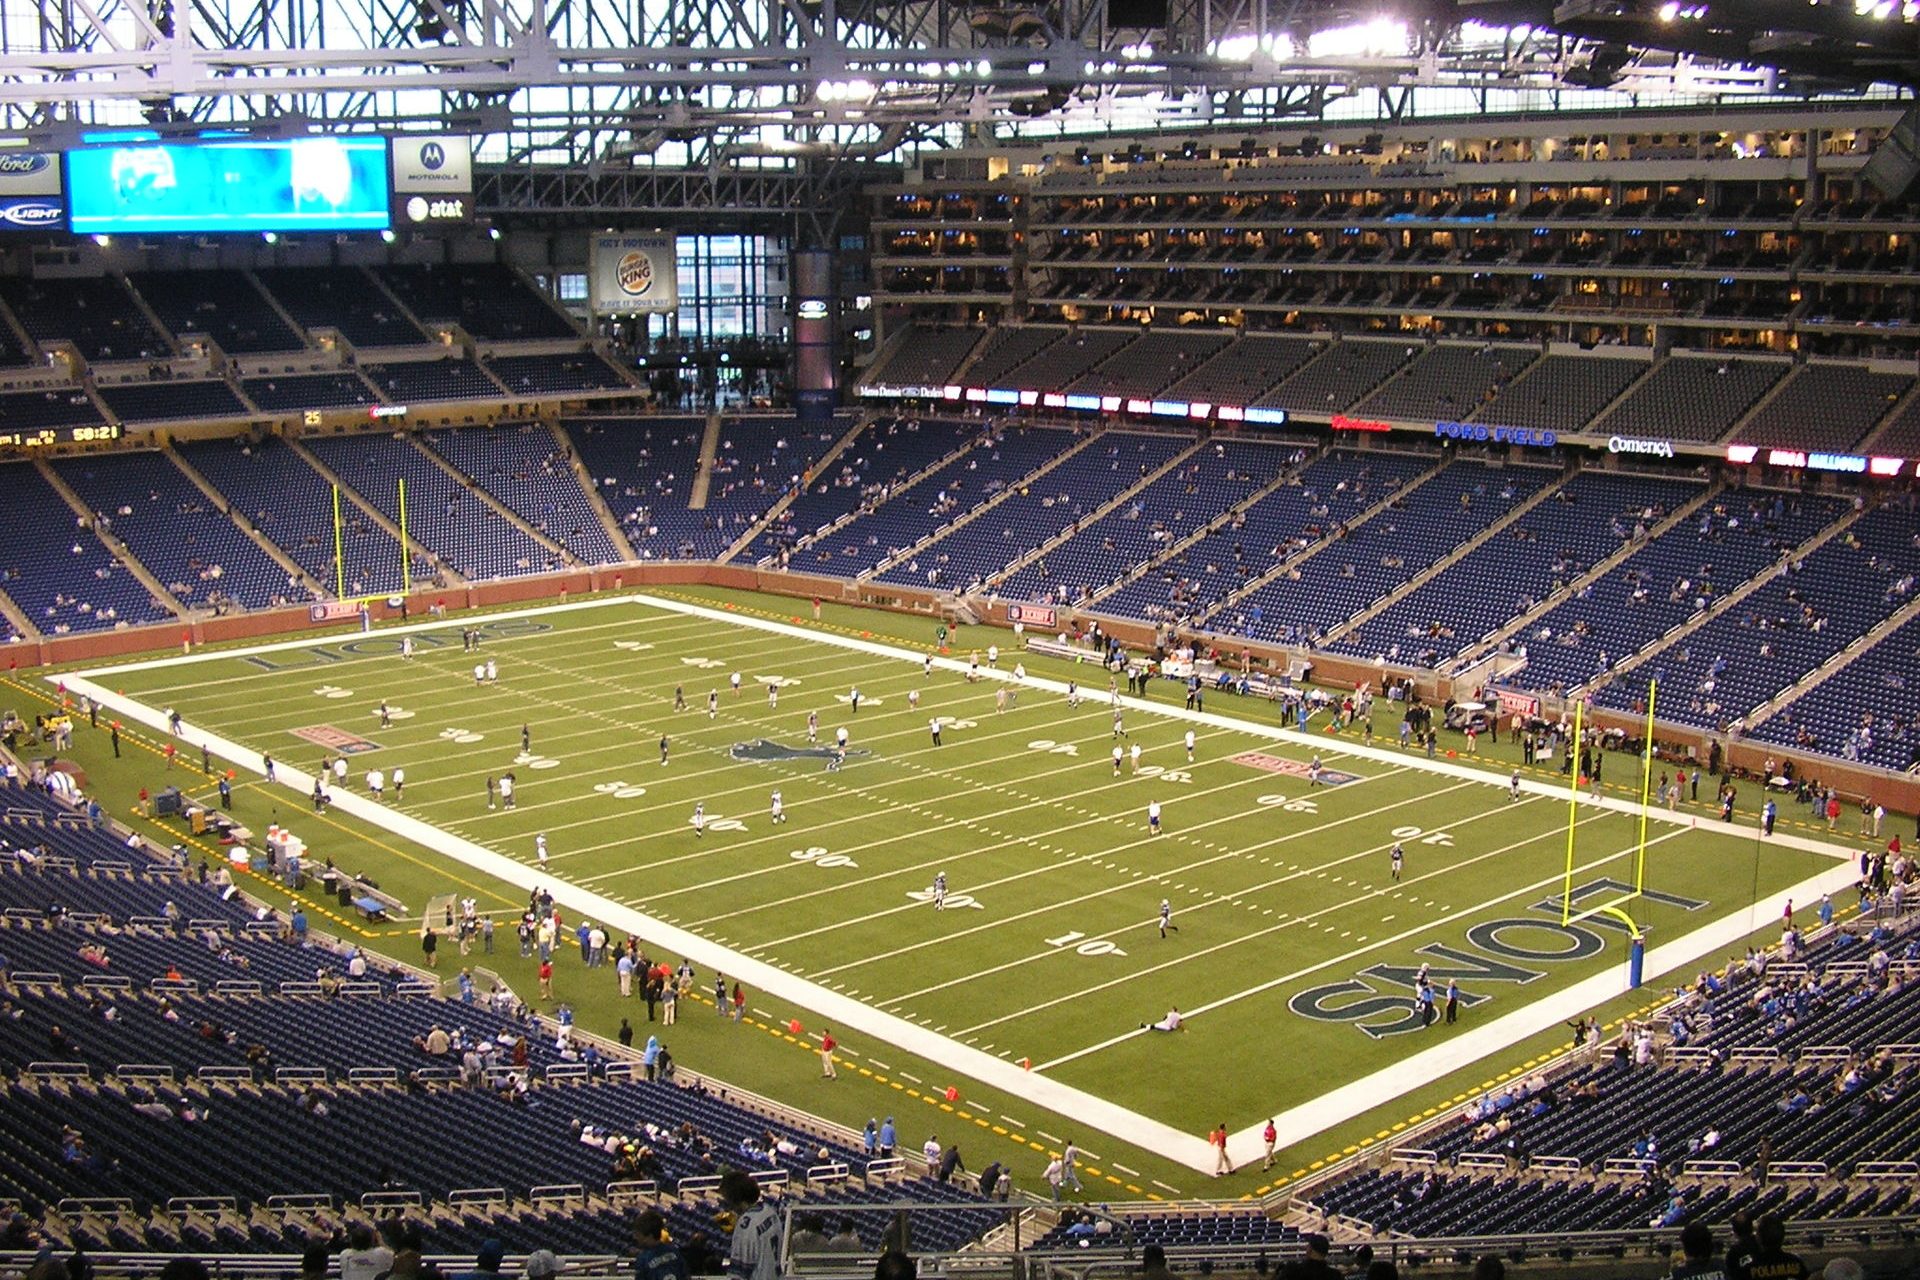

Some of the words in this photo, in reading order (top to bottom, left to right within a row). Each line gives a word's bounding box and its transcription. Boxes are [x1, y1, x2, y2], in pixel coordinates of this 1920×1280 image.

[13, 208, 62, 219] LIGHT
[620, 258, 649, 275] BURGER
[621, 266, 651, 287] KING
[1436, 422, 1489, 441] FORD
[1493, 427, 1557, 446] FIELD
[790, 847, 851, 868] 30
[1044, 931, 1115, 955] 10
[1288, 876, 1710, 1040] LIONS
